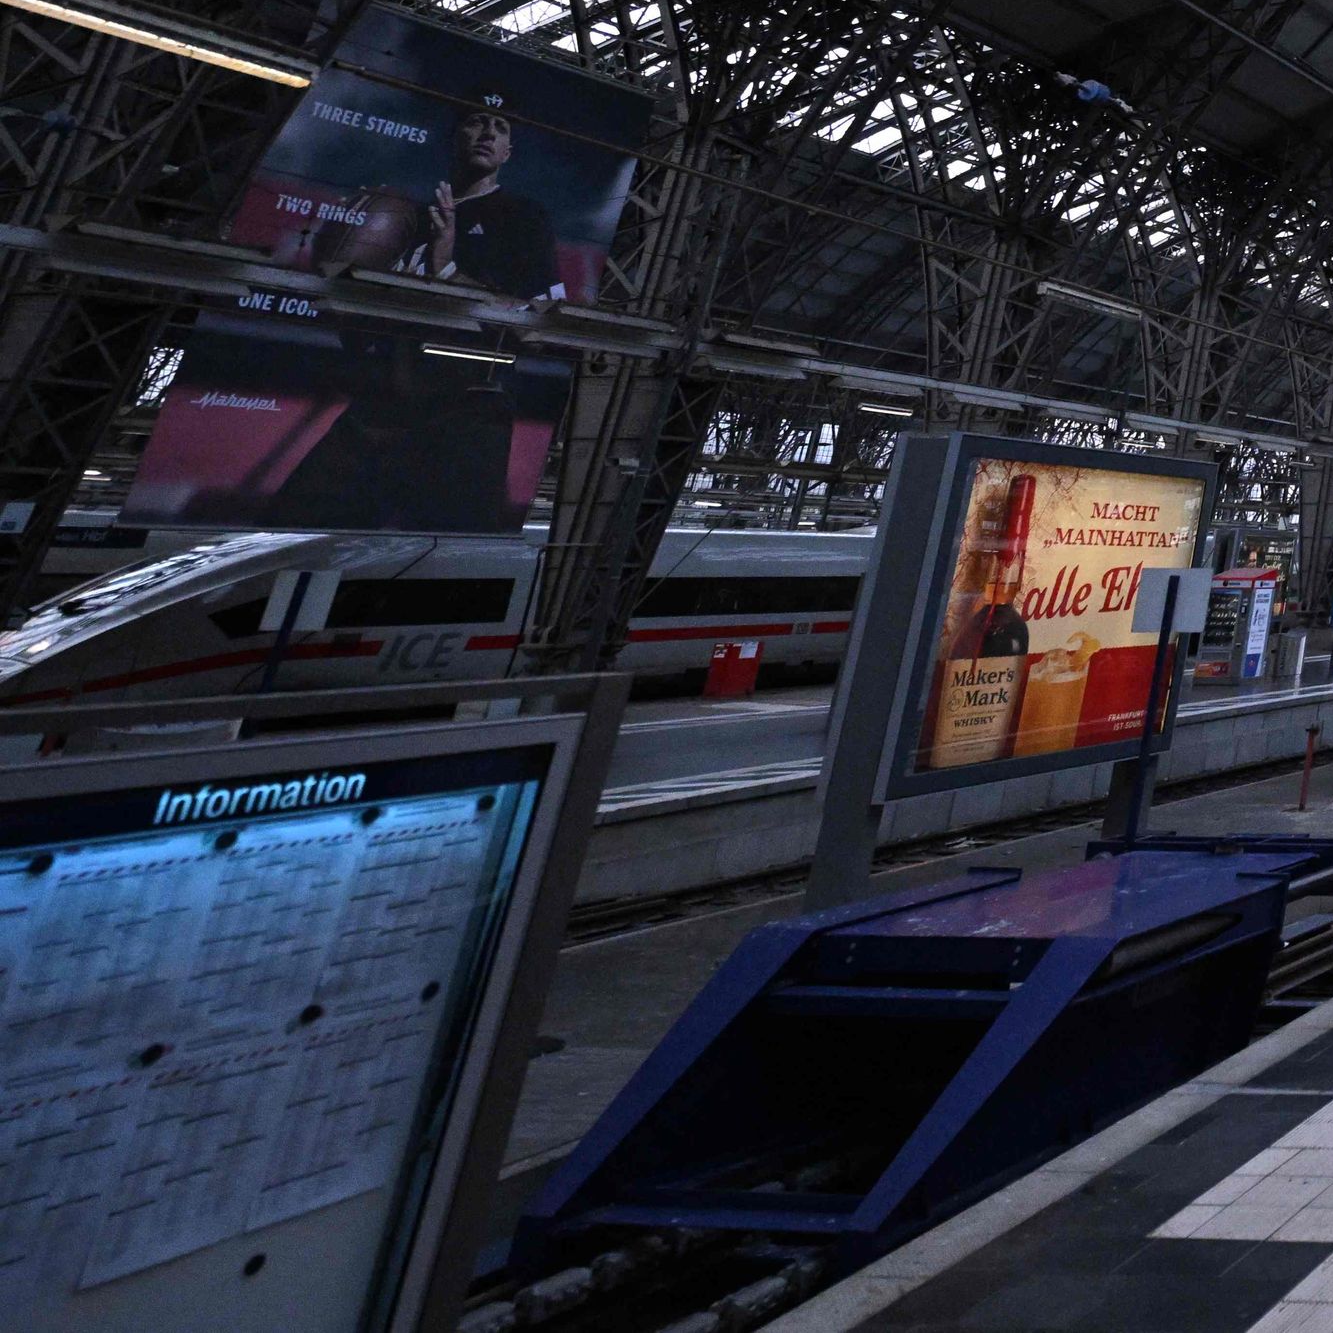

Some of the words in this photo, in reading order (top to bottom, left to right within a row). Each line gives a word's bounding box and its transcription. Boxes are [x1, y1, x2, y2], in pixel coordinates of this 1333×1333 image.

[312, 101, 363, 128] THREE
[365, 115, 429, 145] STRIPES
[275, 193, 313, 215] TWO
[317, 200, 367, 226] RINGS
[1090, 502, 1160, 522] MACHT
[1021, 564, 1092, 623] alle
[380, 632, 464, 672] ICE
[962, 687, 1009, 709] Mark
[953, 715, 996, 729] WHISKY
[1113, 722, 1124, 731] IST
[152, 770, 367, 826] Information
